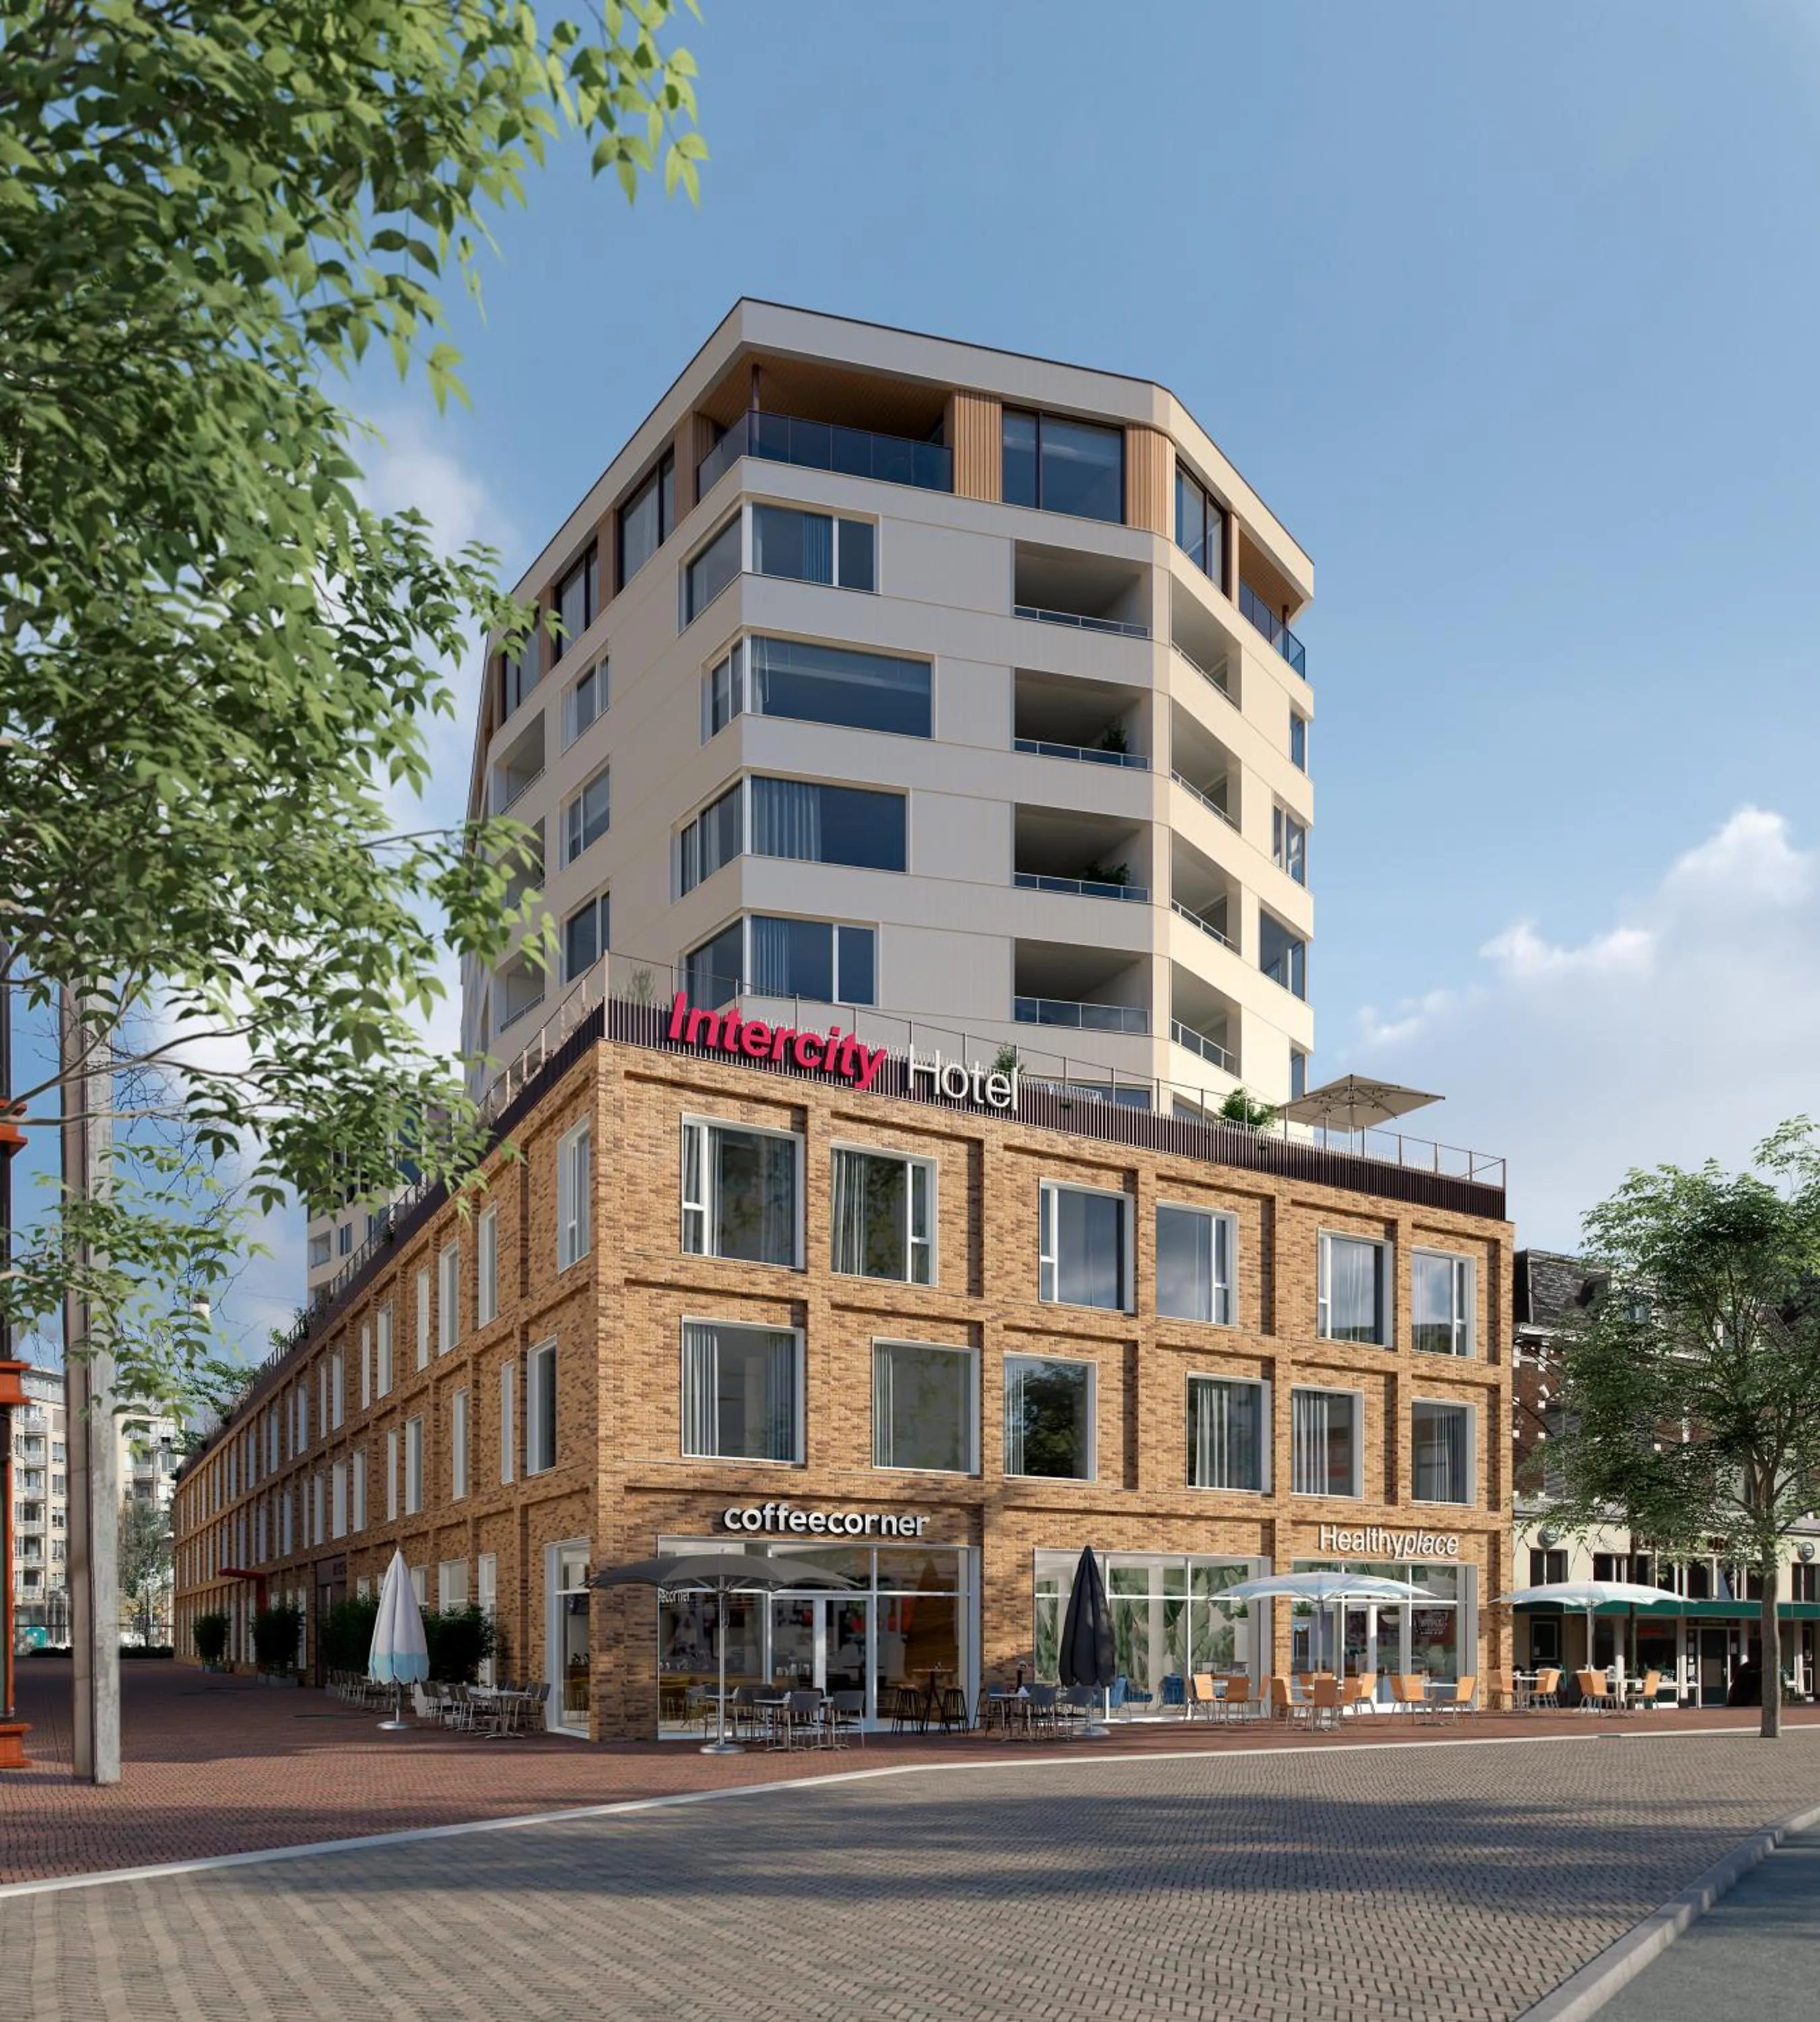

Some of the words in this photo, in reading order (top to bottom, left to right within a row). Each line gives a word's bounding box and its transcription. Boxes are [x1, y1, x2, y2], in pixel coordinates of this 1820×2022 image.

[668, 992, 887, 1089] Intercity
[909, 1044, 1019, 1111] Hotel
[723, 1503, 930, 1535] coffeecorner
[1320, 1523, 1459, 1560] Healthyplace
